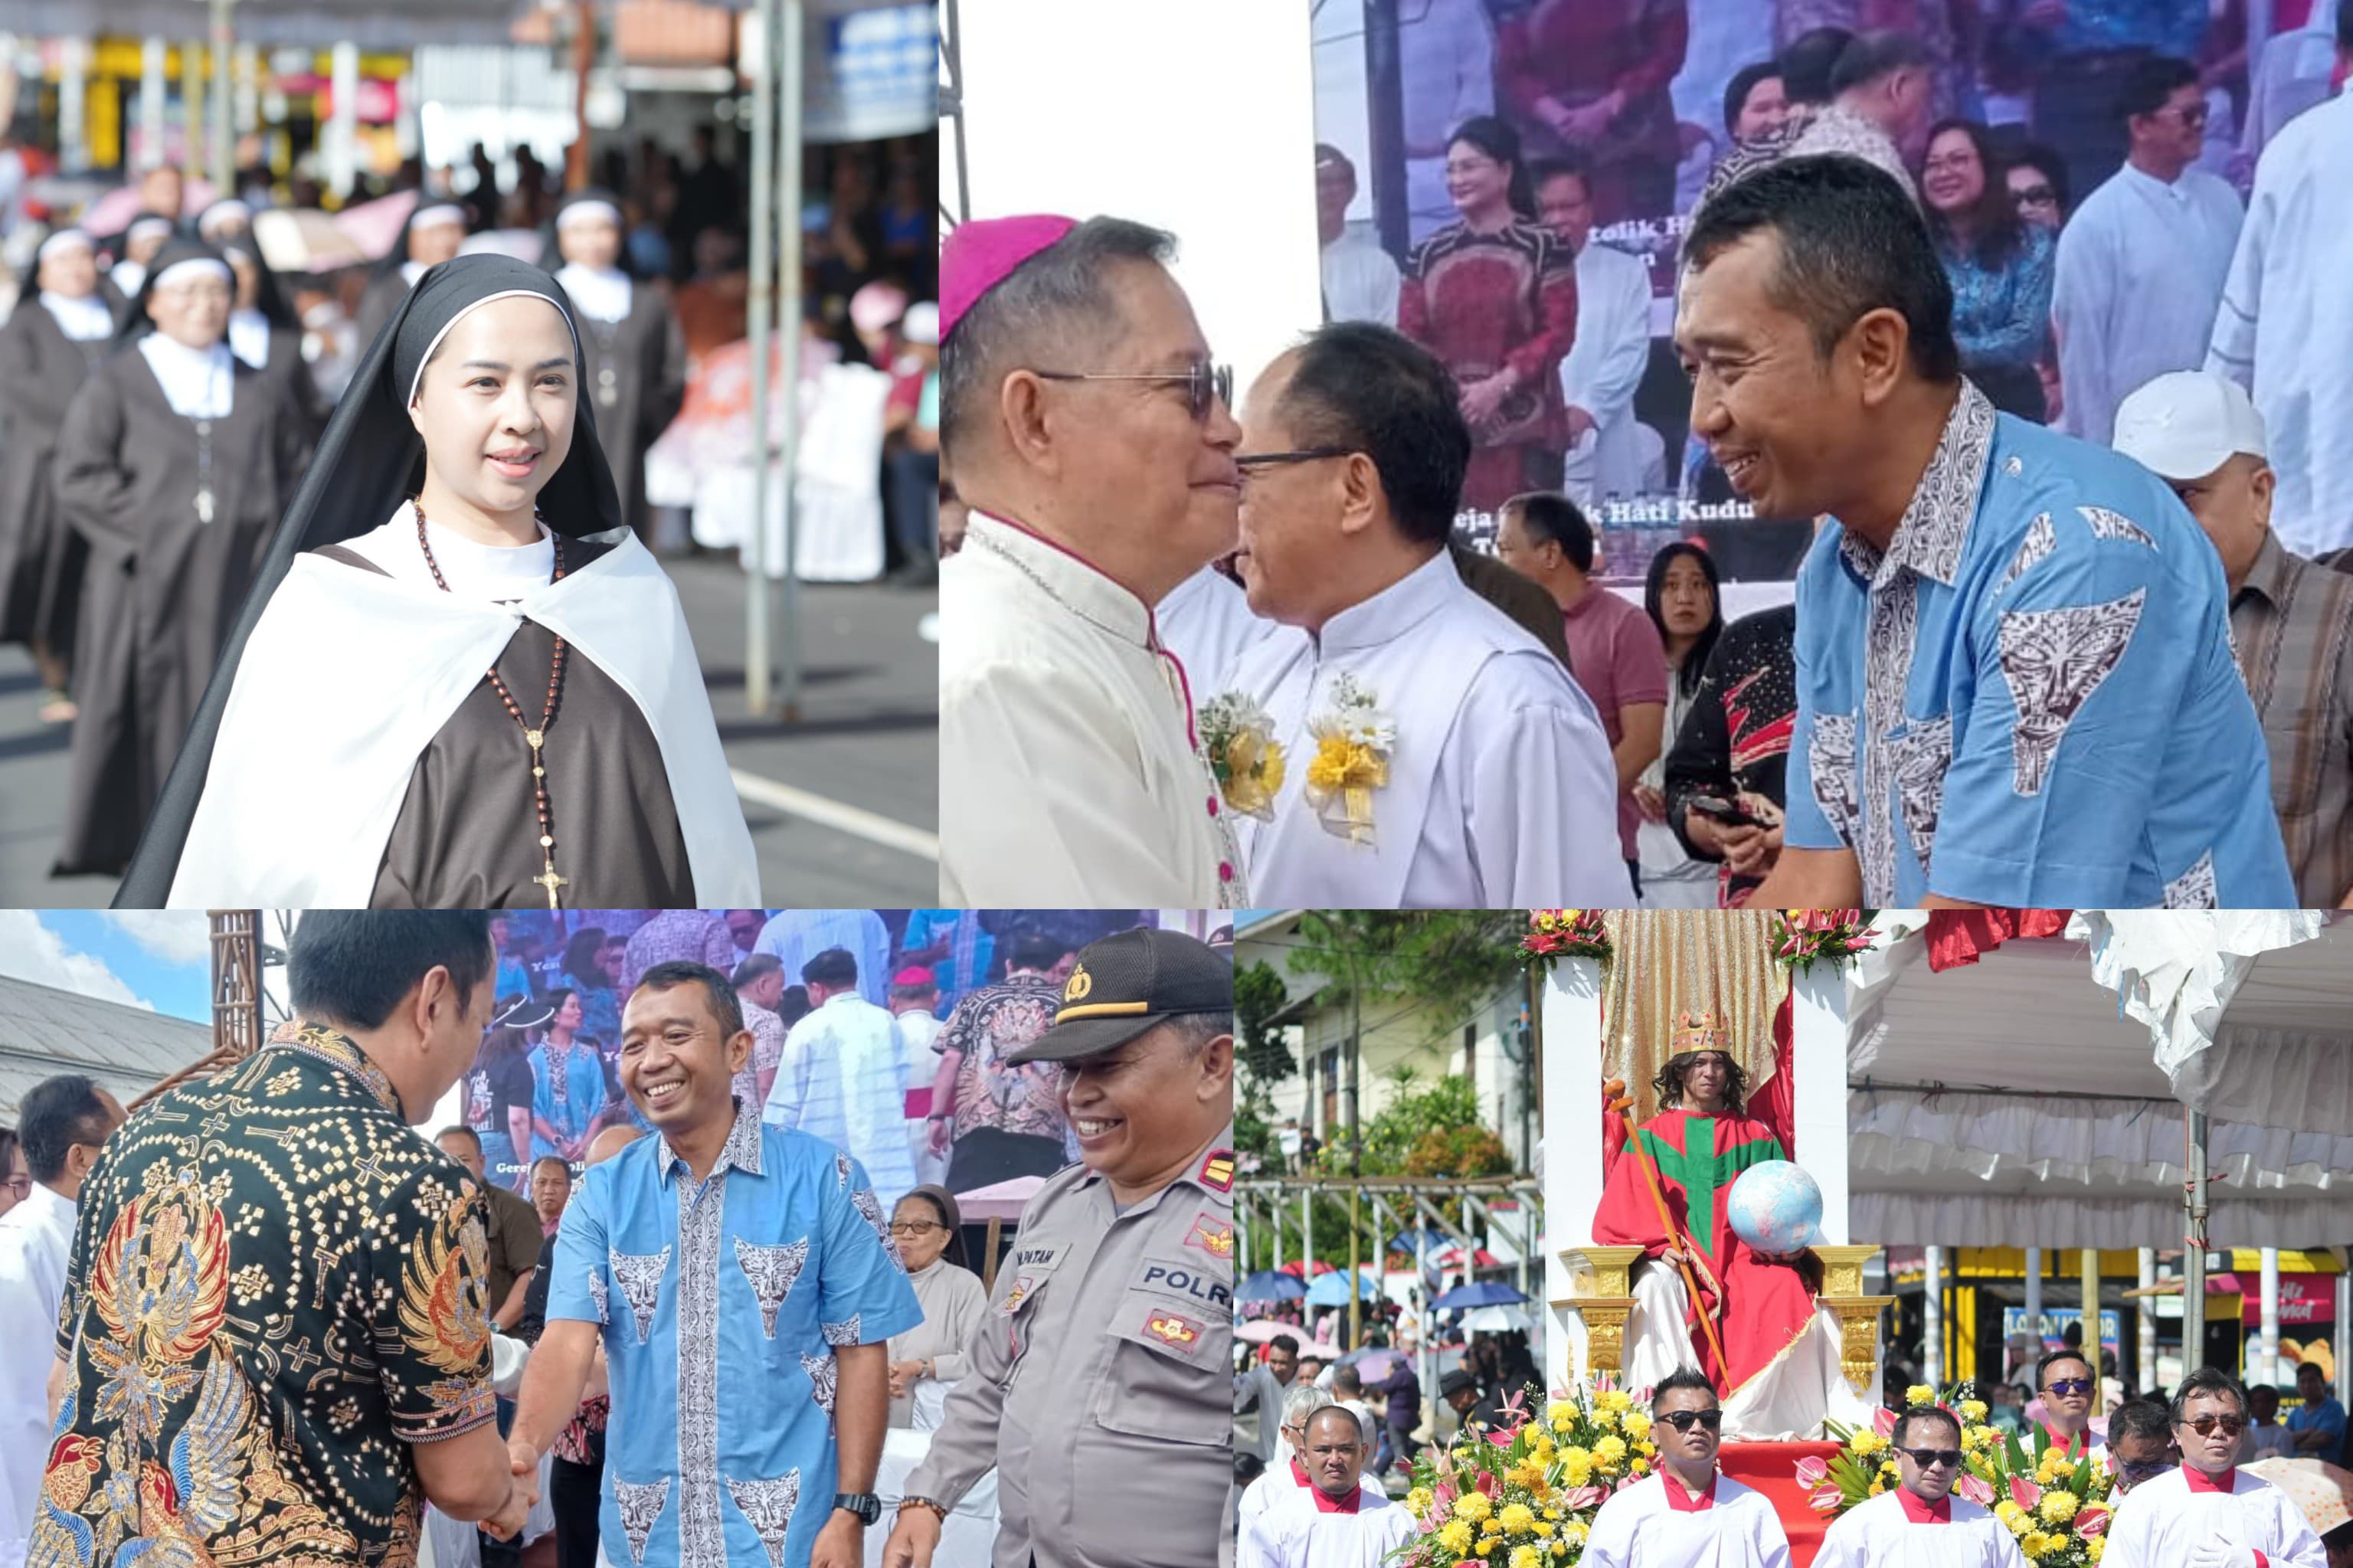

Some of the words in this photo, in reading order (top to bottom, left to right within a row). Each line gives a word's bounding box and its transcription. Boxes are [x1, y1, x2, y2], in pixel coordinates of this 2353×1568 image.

[1611, 501, 1668, 522] Hati
[1677, 499, 1756, 519] Kudu
[496, 1163, 531, 1174] Gerej
